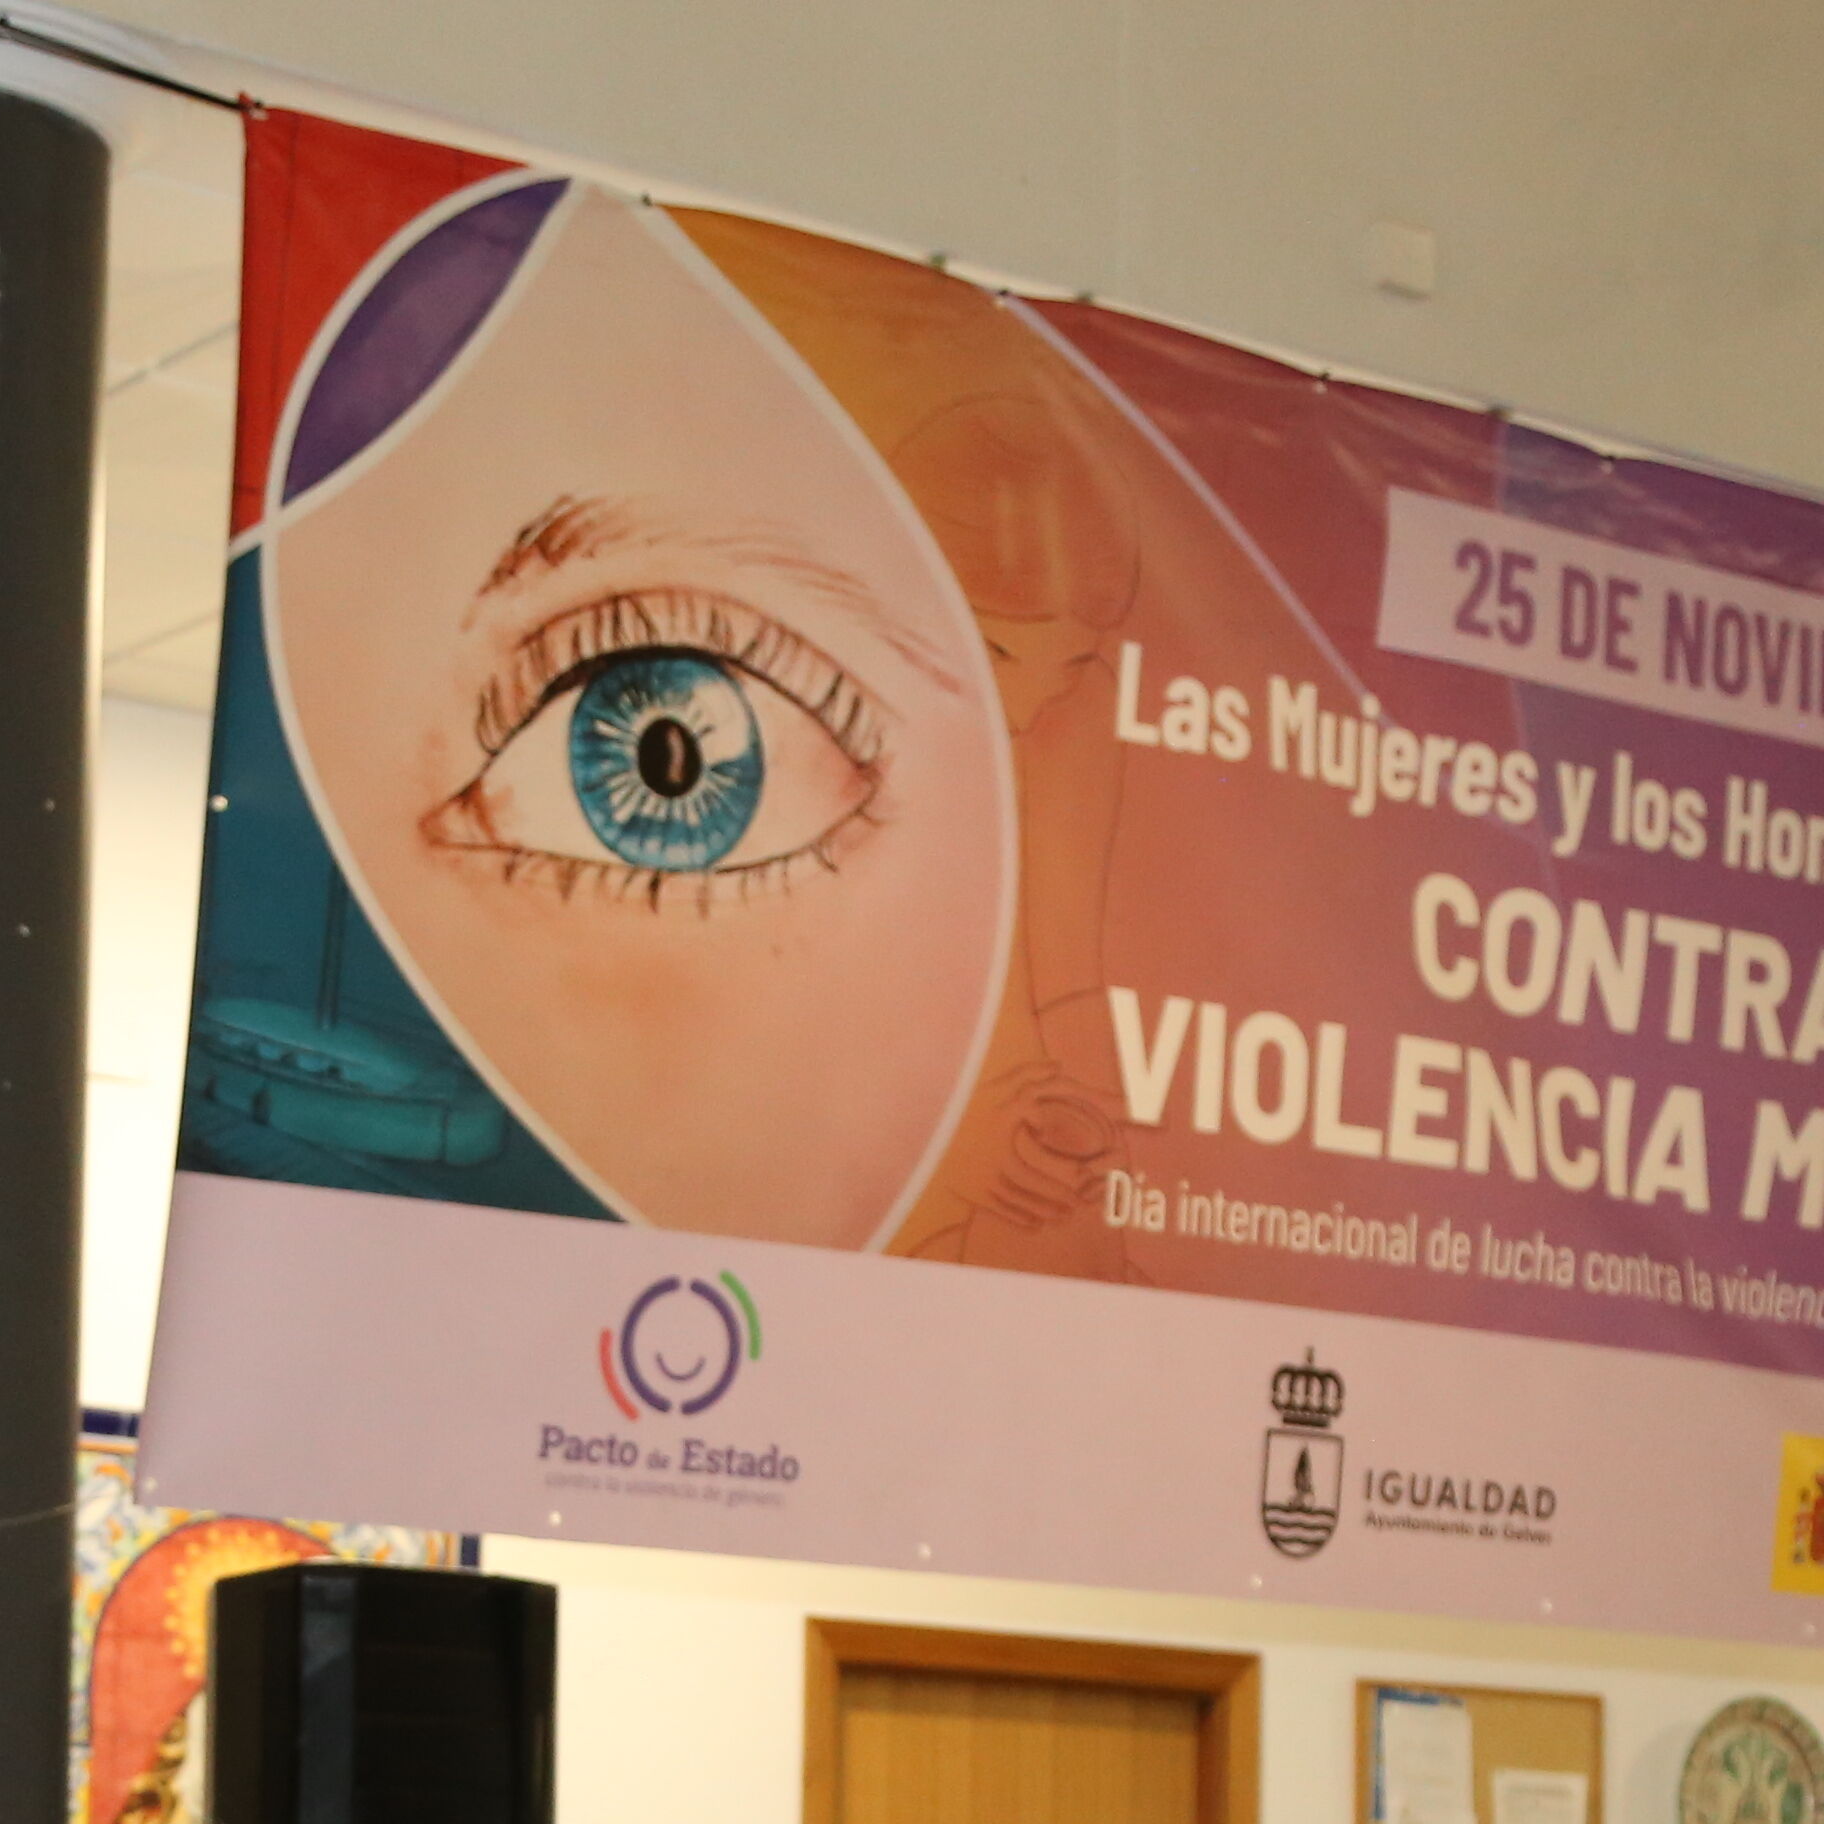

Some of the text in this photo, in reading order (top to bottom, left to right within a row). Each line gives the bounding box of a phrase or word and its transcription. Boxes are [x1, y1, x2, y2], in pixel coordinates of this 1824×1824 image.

[1452, 538, 1538, 649] 25
[1558, 563, 1642, 677] DE
[1114, 638, 1252, 763] Las
[1268, 672, 1539, 824] Mujeres
[1551, 759, 1596, 858] y
[1610, 749, 1709, 861] los
[1106, 984, 1712, 1214] VIOLENCIA
[1177, 1177, 1420, 1268] internacional
[1425, 1215, 1471, 1275] de
[1480, 1221, 1576, 1290] lucha
[1583, 1247, 1684, 1306] contra
[1687, 1262, 1715, 1311] la
[537, 1423, 639, 1469] Pacto
[680, 1437, 800, 1483] Estado
[1363, 1467, 1557, 1522] IGUALDAD
